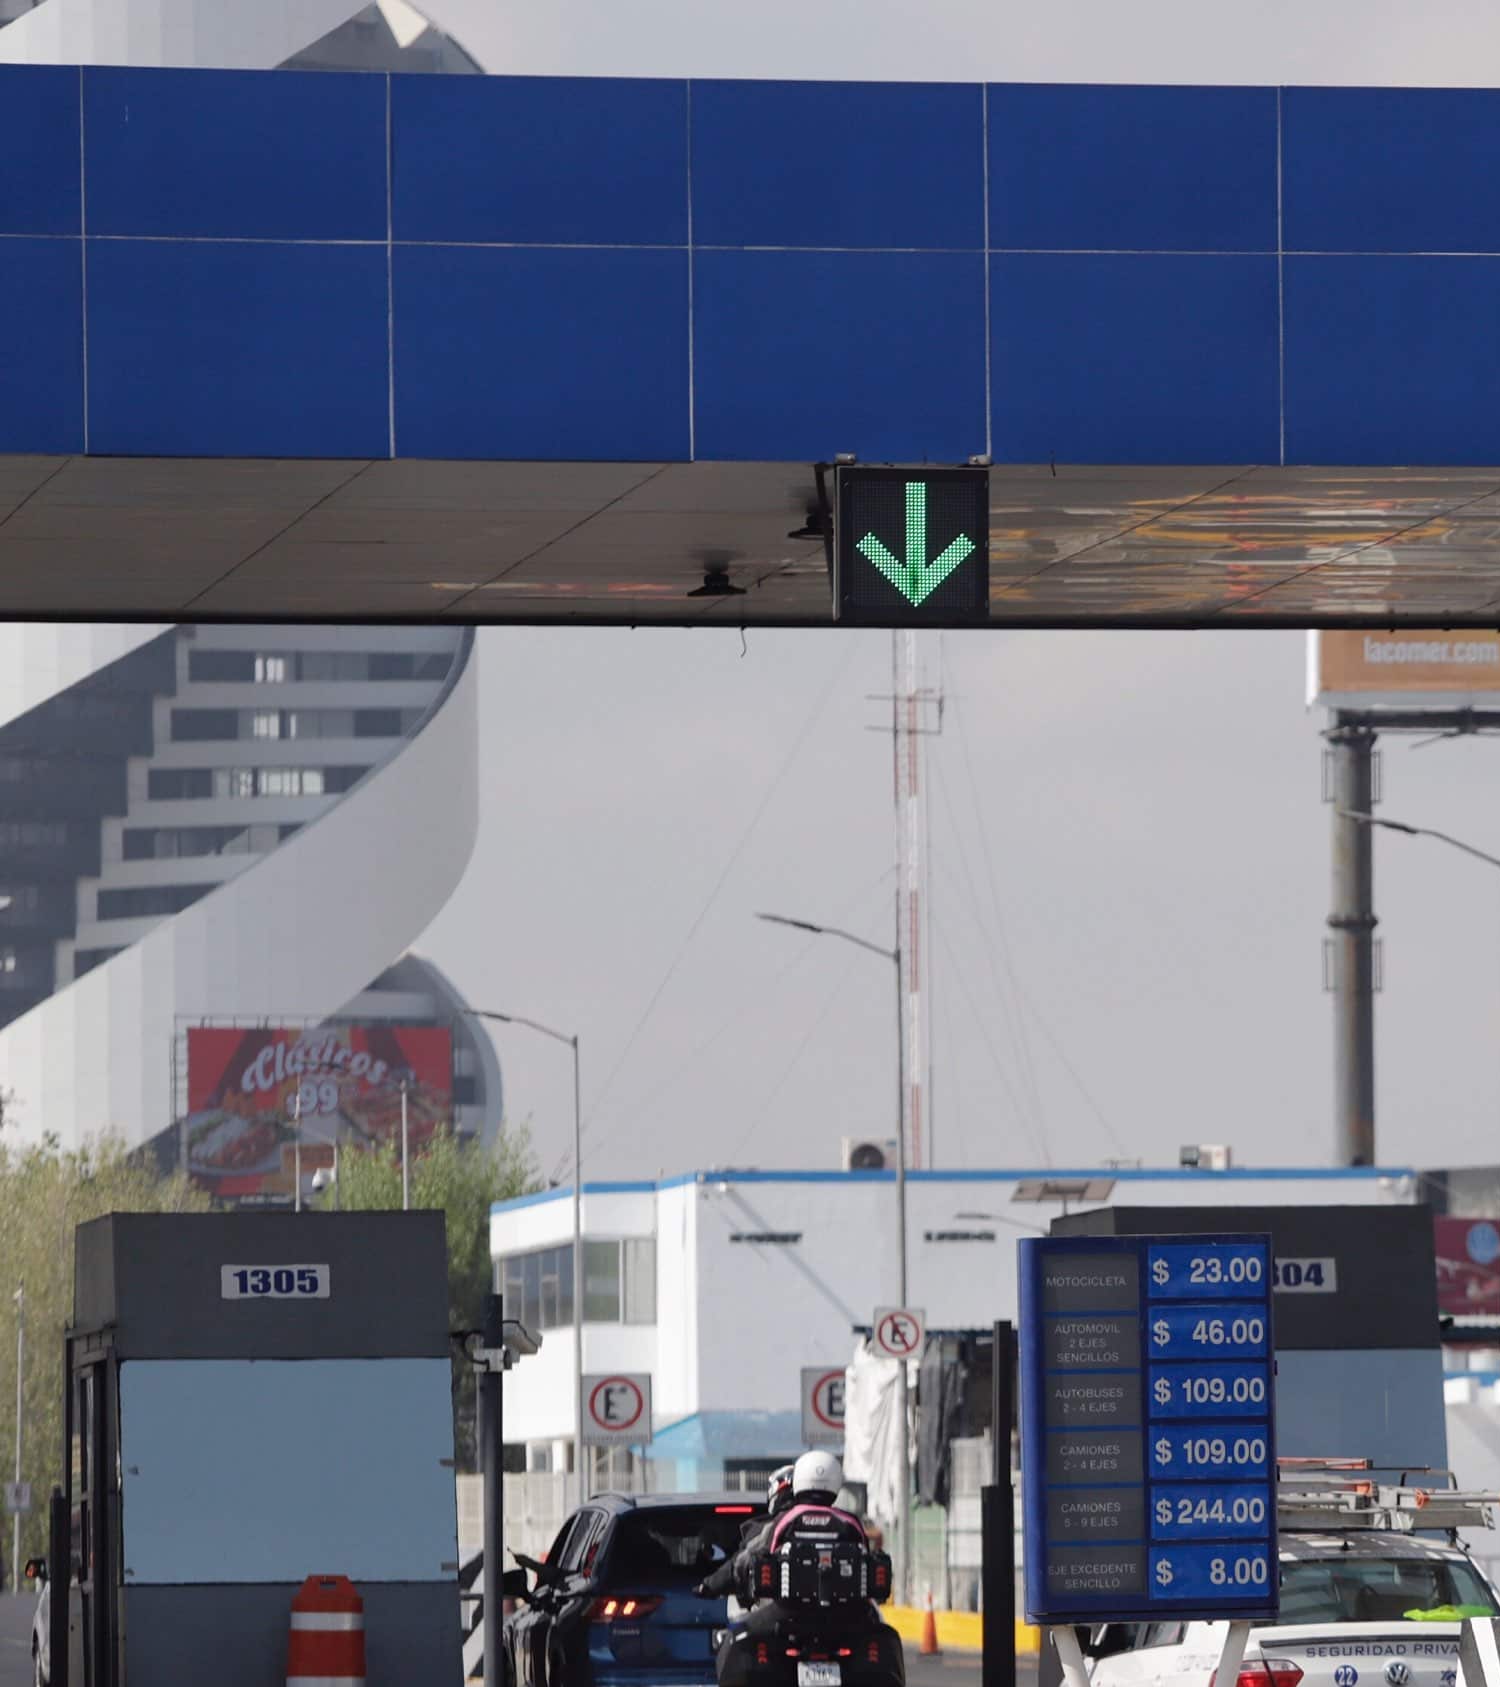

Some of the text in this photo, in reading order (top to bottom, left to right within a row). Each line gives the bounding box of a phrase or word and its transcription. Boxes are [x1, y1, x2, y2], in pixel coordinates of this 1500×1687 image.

[1363, 635, 1499, 665] lacomer.com
[1152, 1257, 1262, 1286] $ 23.00
[232, 1268, 319, 1295] 1305
[1046, 1275, 1127, 1288] MOTOCICLETA
[1055, 1323, 1120, 1335] AUTOMOVIL
[1152, 1319, 1264, 1348] $ 46.00
[1079, 1337, 1107, 1349] EJES
[1056, 1351, 1120, 1363] SENCILLOS
[1055, 1387, 1124, 1400] AUTOBUSES
[1153, 1376, 1265, 1406] $ 109.00
[1088, 1401, 1117, 1413] EJES
[1060, 1445, 1120, 1456] CAMIONES
[1154, 1436, 1266, 1467] $ 109.00
[1090, 1458, 1118, 1470] EJES
[1060, 1502, 1121, 1513] CAMIONES
[1090, 1515, 1119, 1527] EJES
[1070, 1562, 1137, 1575] EXCEDENTE
[1155, 1557, 1267, 1587] $ 8.00
[1064, 1577, 1120, 1589] SENCILLO
[1306, 1644, 1407, 1658] SEGURIDAD
[1338, 1668, 1356, 1687] 22
